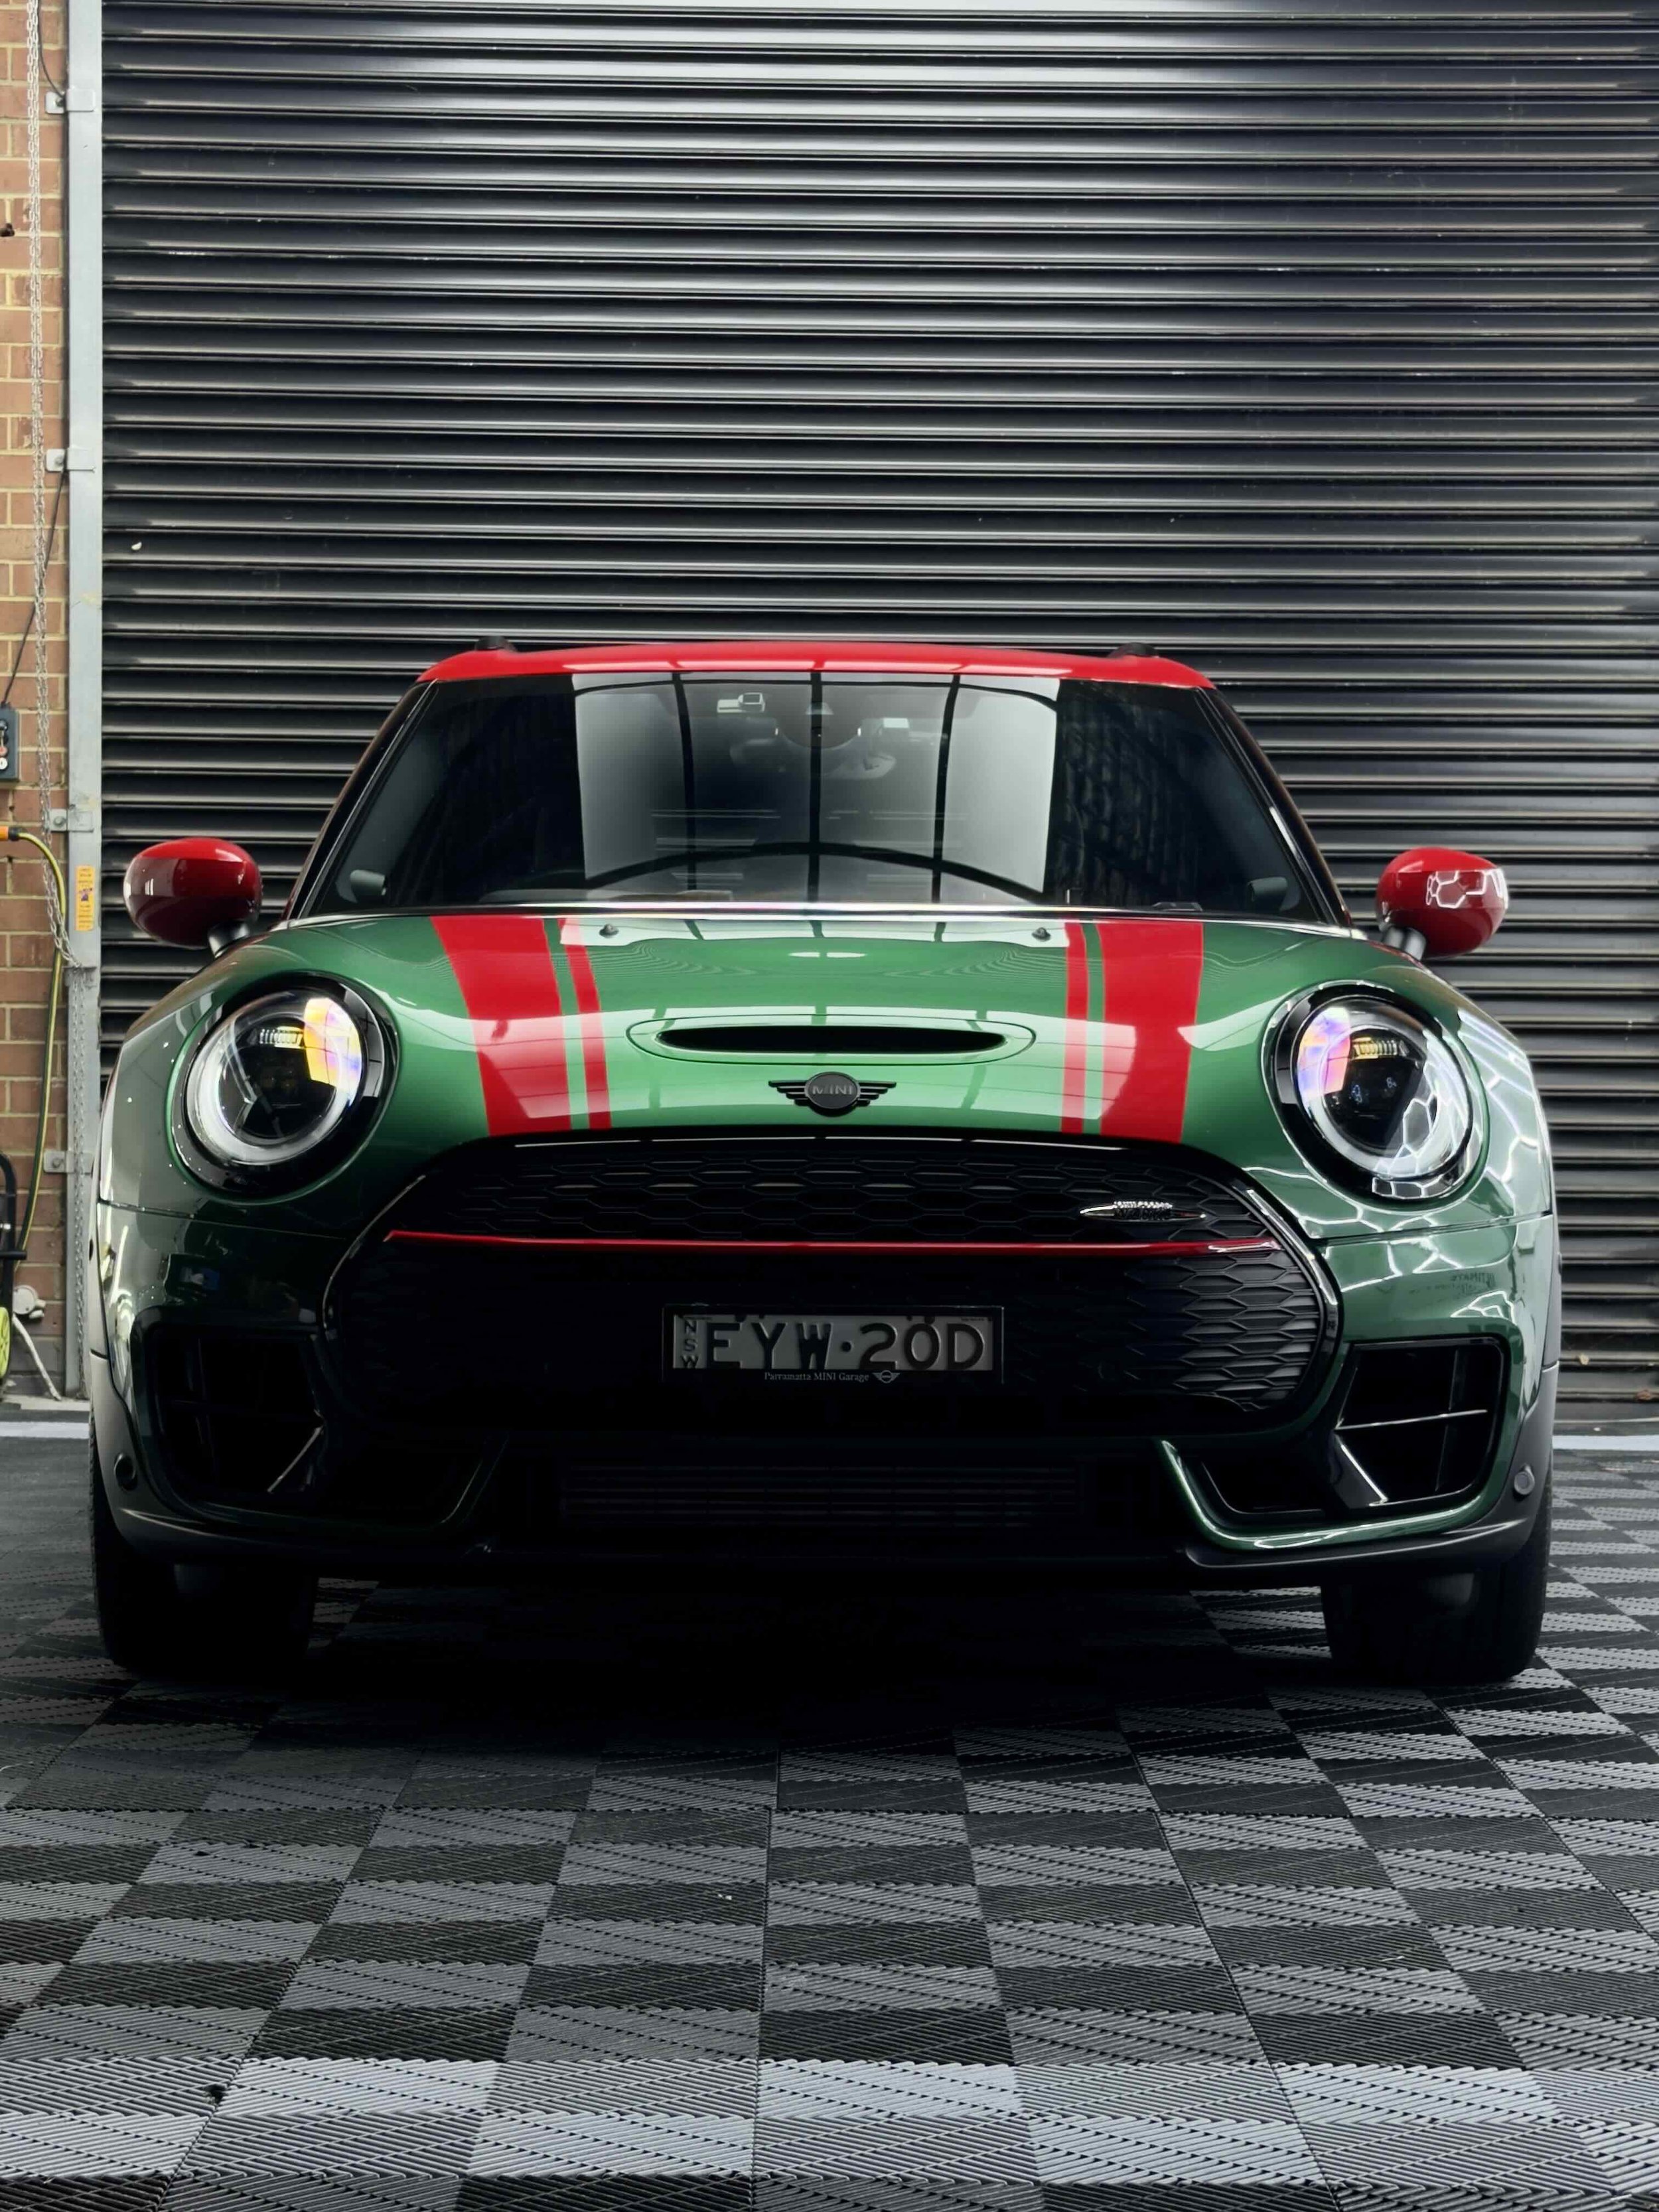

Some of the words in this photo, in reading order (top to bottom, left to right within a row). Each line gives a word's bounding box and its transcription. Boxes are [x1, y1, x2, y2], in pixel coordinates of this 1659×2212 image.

[812, 1084, 853, 1096] MINI
[764, 1372, 812, 1381] Parramatta
[814, 1372, 836, 1380] MINI
[838, 1372, 870, 1382] Garage
